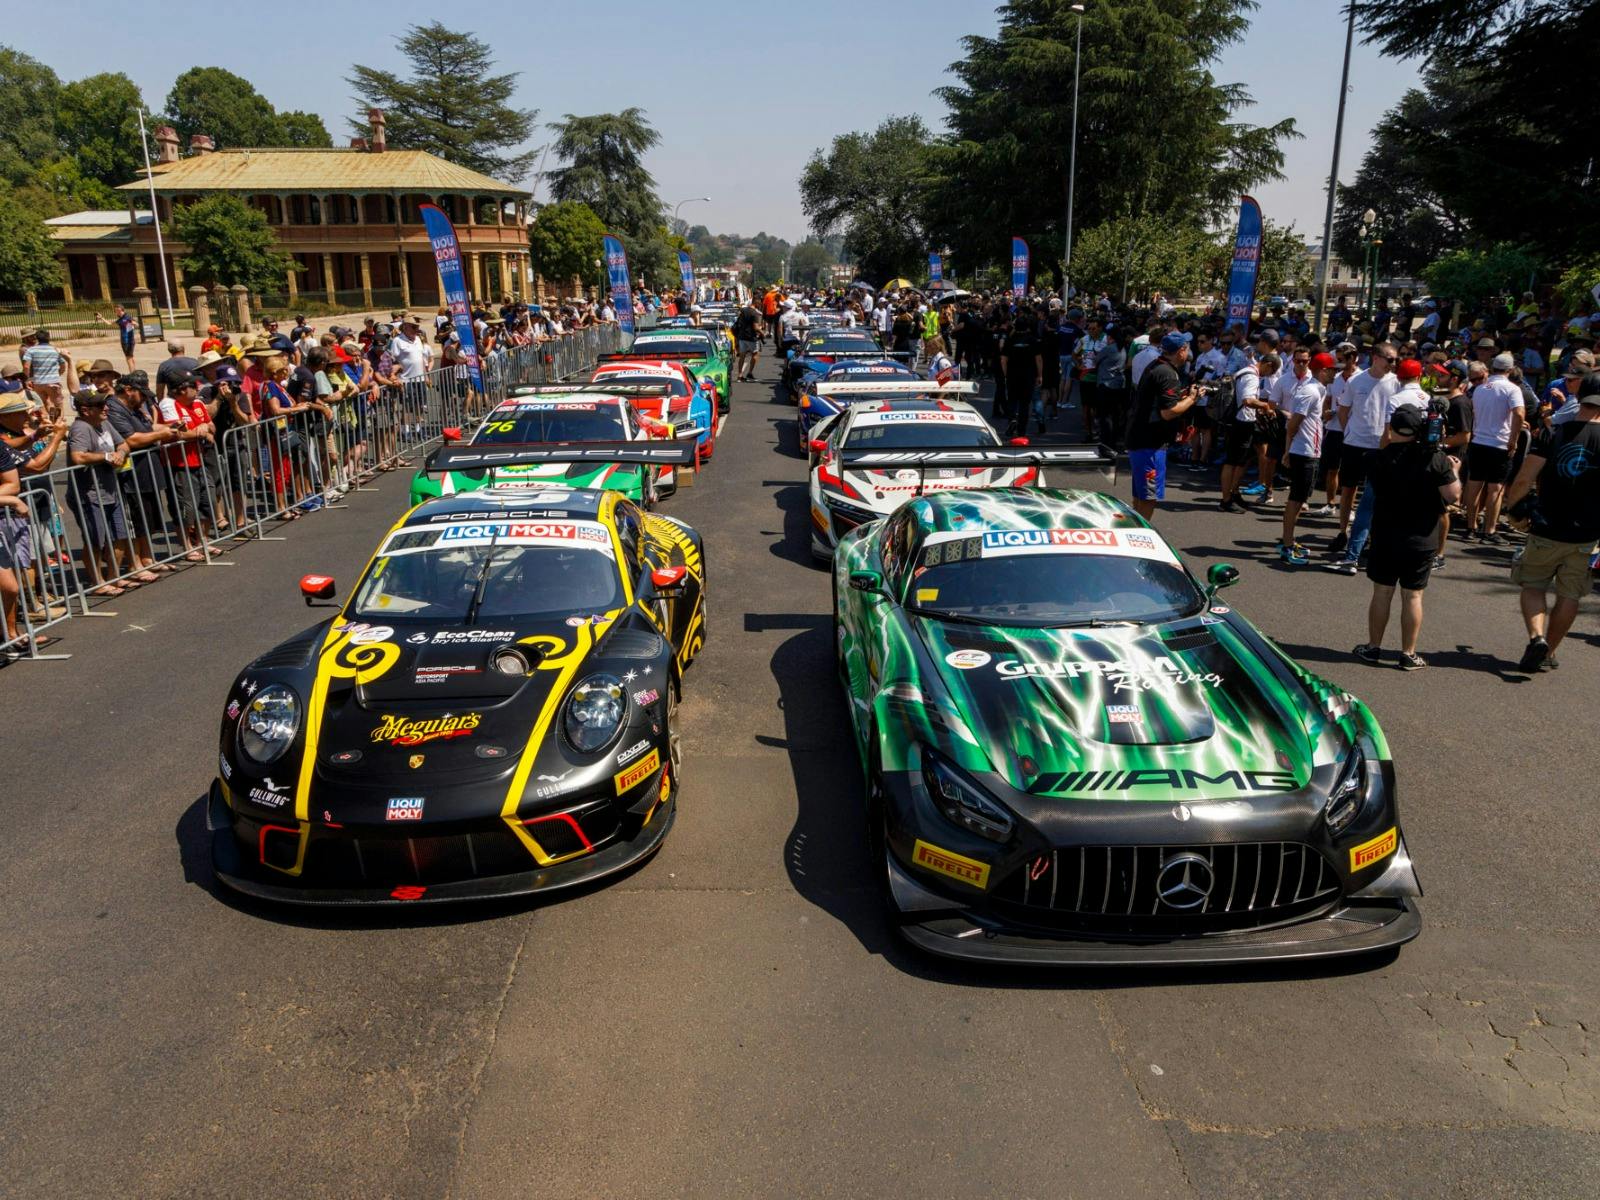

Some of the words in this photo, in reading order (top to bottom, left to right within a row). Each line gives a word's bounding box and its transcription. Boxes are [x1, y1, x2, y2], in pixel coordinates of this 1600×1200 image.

[848, 366, 870, 374] LIQUI
[871, 366, 895, 374] MOLY
[882, 413, 916, 421] LIQUI
[917, 413, 954, 421] MOLY
[485, 419, 517, 434] 76
[448, 449, 683, 463] PORSCHE
[430, 510, 569, 522] PORSCHE
[450, 525, 507, 538] LIQUI
[511, 525, 576, 538] MOLY
[985, 531, 1049, 547] LIQUI
[1052, 530, 1113, 545] MOLY
[435, 631, 515, 640] EcoClean
[1108, 705, 1138, 714] LIQUI
[1110, 713, 1141, 722] MOLY
[371, 713, 481, 745] Meguiar's
[620, 754, 656, 789] PIRELLI
[1116, 769, 1301, 792] AMG
[249, 788, 287, 806] GULLWING
[390, 799, 422, 808] LIQUI
[388, 809, 421, 819] MOLY
[1355, 834, 1394, 866] PIRELLI
[918, 846, 983, 881] PIRELLI
